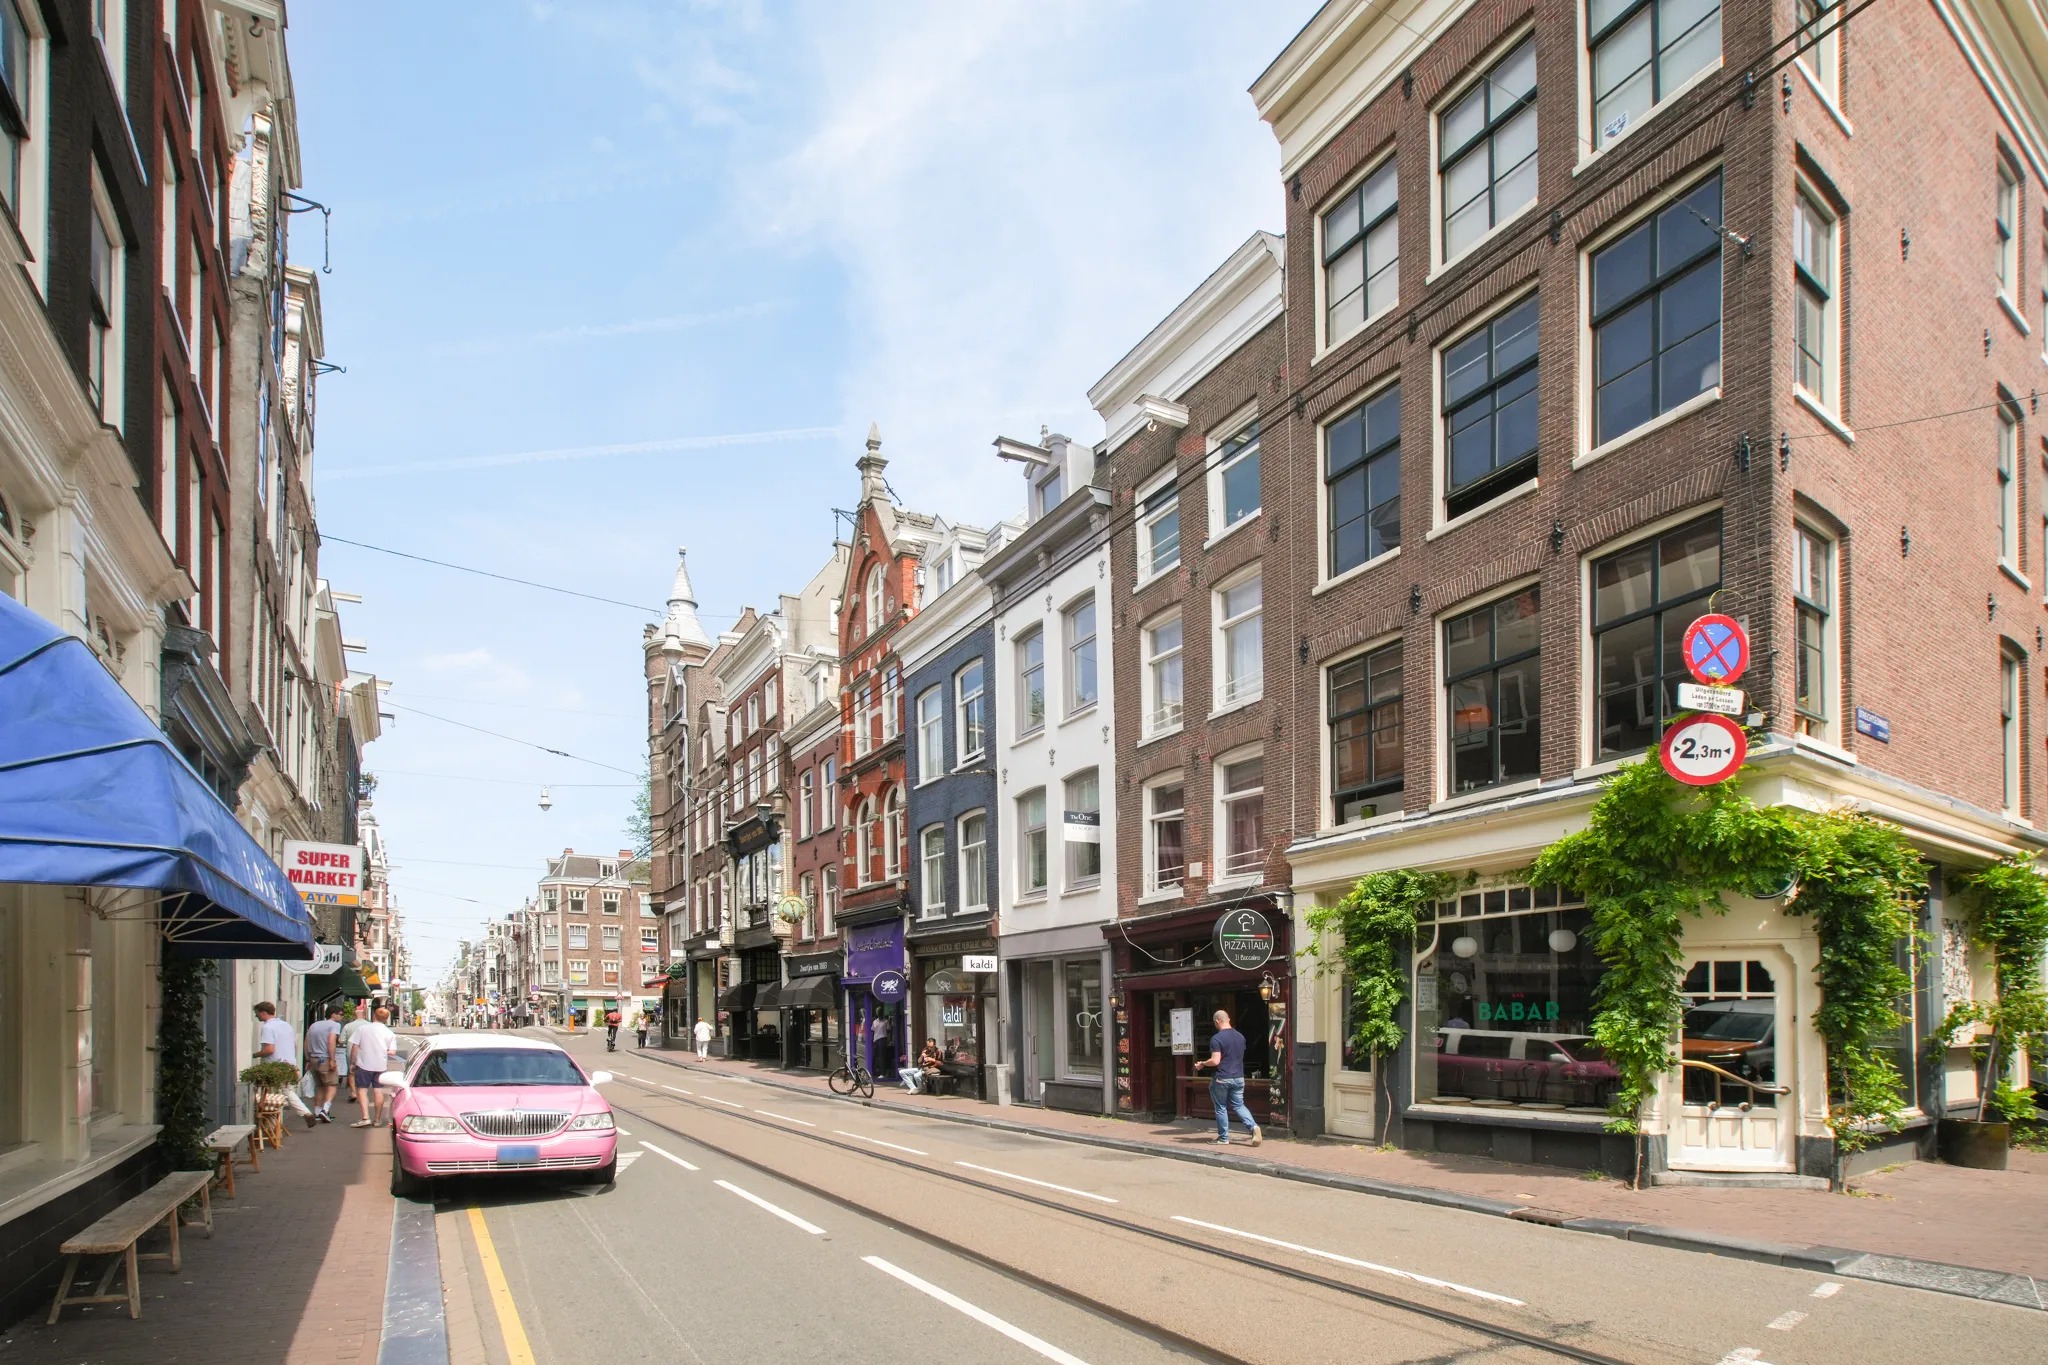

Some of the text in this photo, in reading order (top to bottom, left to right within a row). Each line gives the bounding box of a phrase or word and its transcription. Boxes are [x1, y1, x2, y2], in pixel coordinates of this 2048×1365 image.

[1680, 738, 1722, 760] 2,3m
[297, 850, 350, 868] SUPER
[288, 868, 357, 888] MARKET
[305, 893, 338, 903] ATM
[1224, 940, 1270, 950] PIZZA ITALIA
[322, 952, 340, 963] ahi
[970, 959, 993, 969] kaldi
[942, 1004, 962, 1023] kaldi
[1478, 1001, 1560, 1021] BABAR
